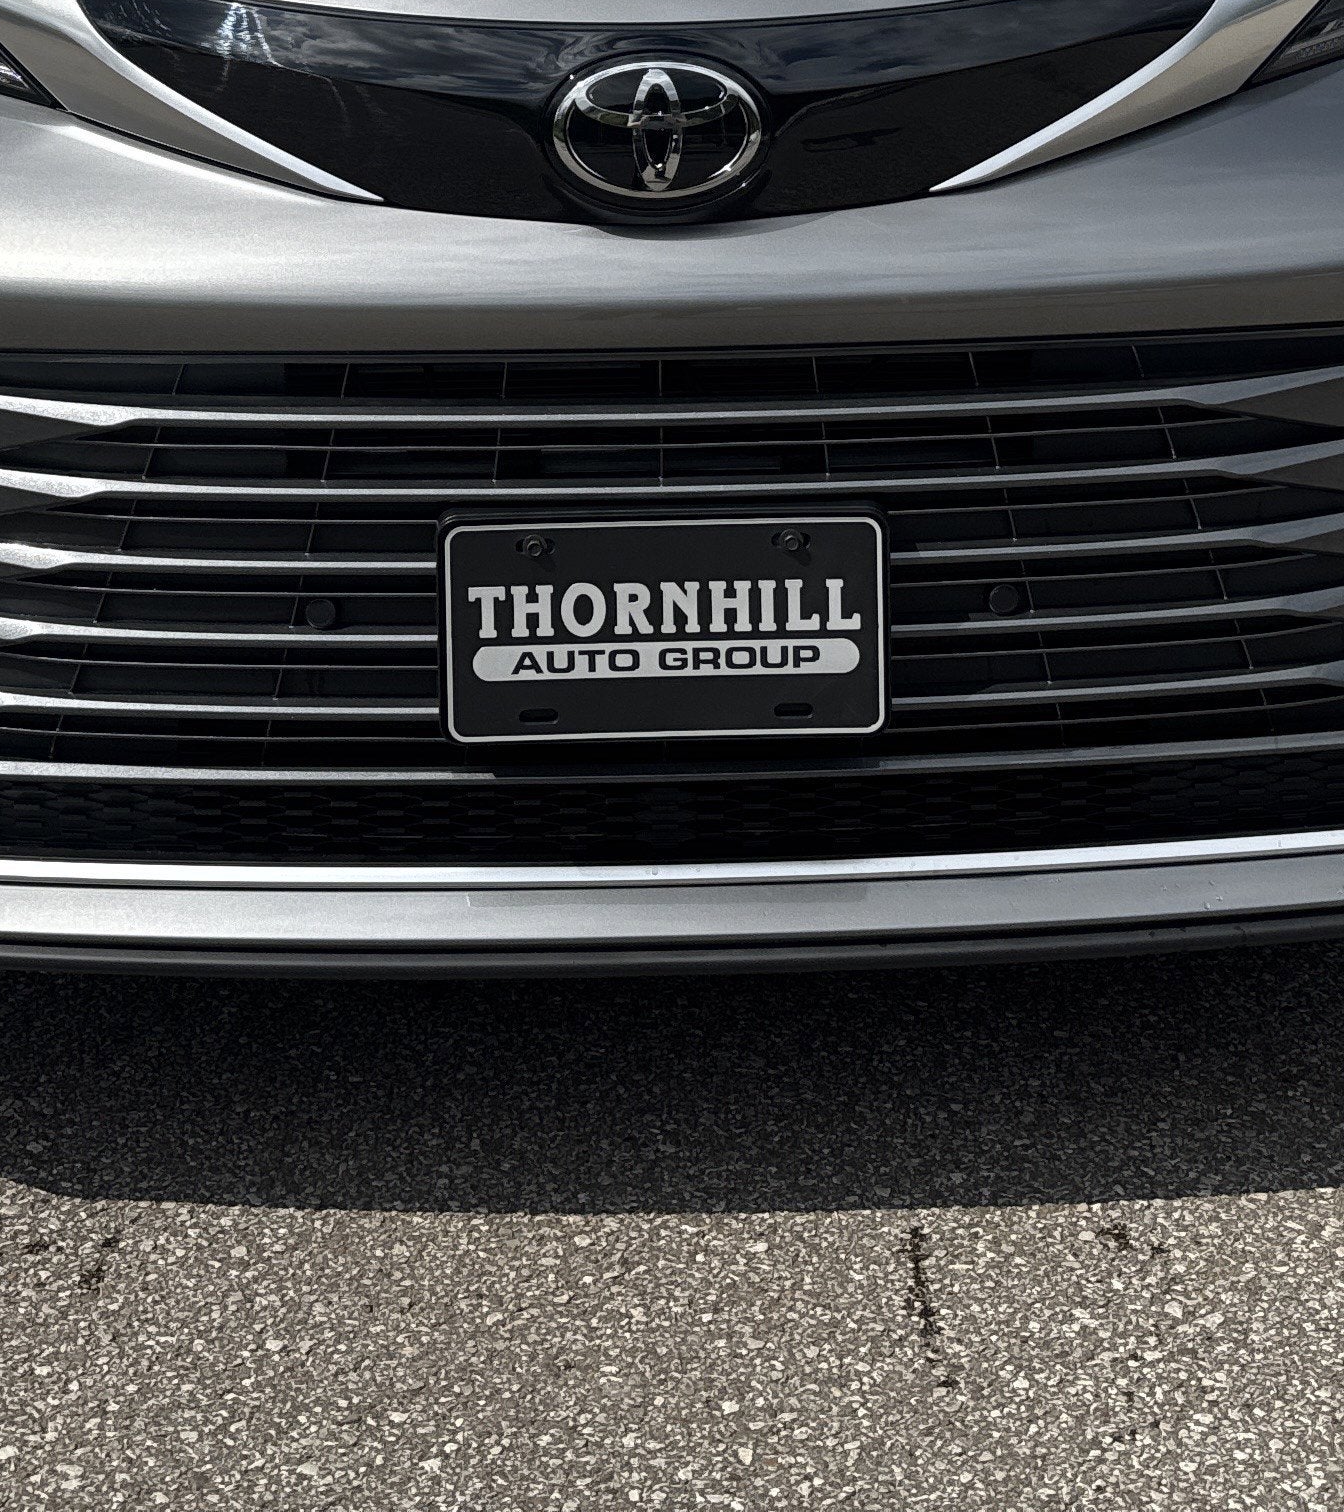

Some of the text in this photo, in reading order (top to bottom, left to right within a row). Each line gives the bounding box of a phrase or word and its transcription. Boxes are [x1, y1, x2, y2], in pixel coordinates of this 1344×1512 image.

[467, 577, 862, 639] THORNHILL
[511, 644, 822, 675] AUTO GROUP
